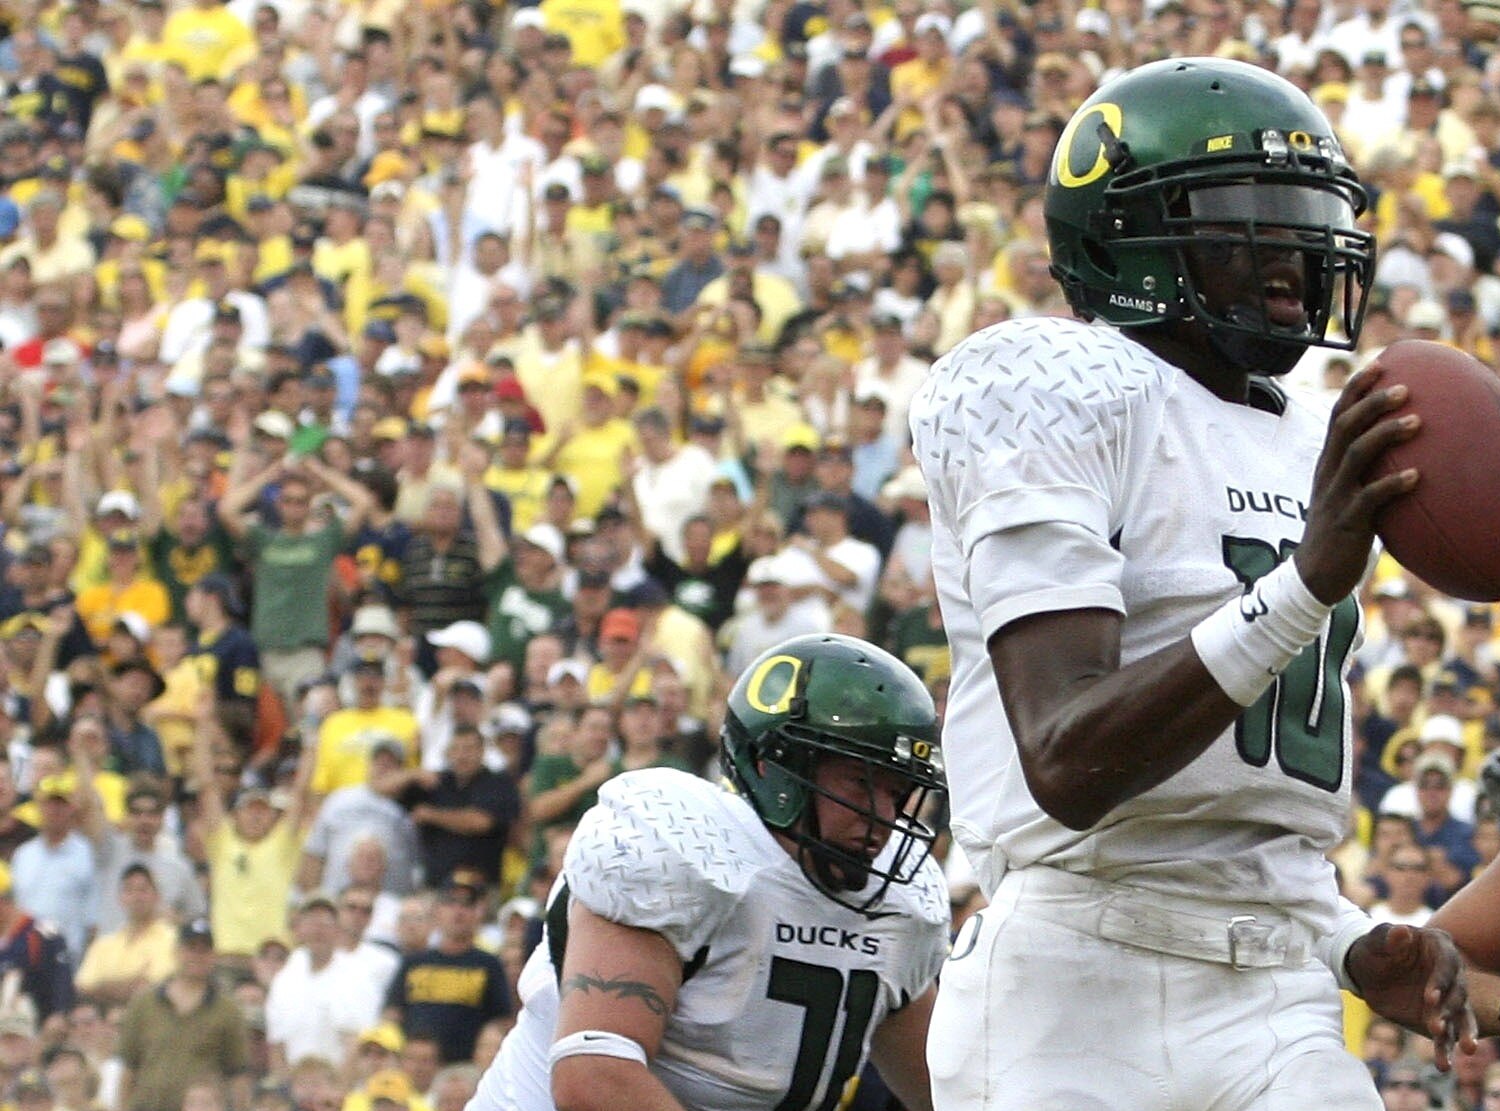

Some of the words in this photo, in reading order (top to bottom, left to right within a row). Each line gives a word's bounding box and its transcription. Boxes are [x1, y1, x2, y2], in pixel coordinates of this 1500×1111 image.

[1057, 103, 1122, 188] O
[1109, 294, 1154, 313] ADAMS
[747, 655, 802, 715] O
[776, 922, 881, 957] DUCKS
